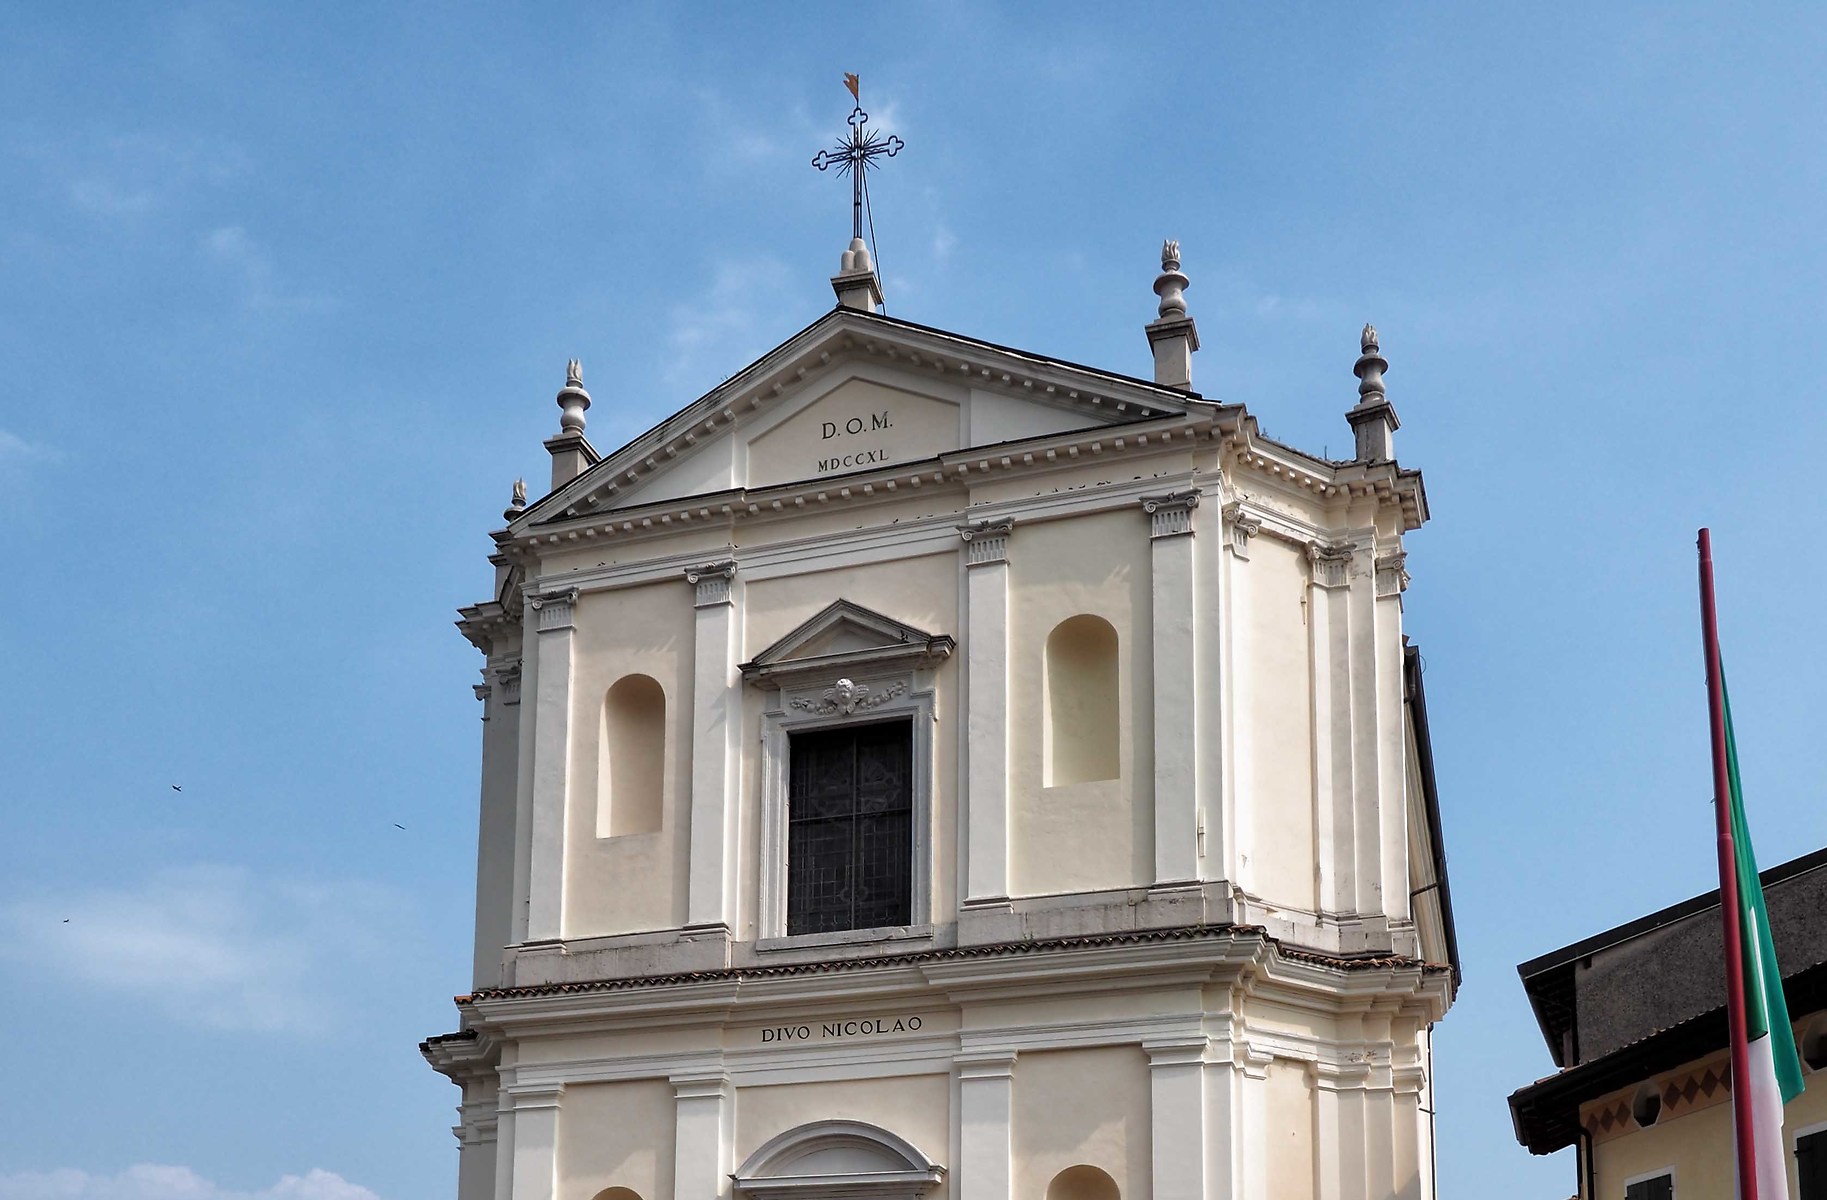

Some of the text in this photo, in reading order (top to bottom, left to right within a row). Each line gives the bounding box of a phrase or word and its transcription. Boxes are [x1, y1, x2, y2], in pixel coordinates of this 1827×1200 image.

[818, 450, 889, 472] MDCCXL
[762, 1016, 922, 1042] DIVO NICOLAO
